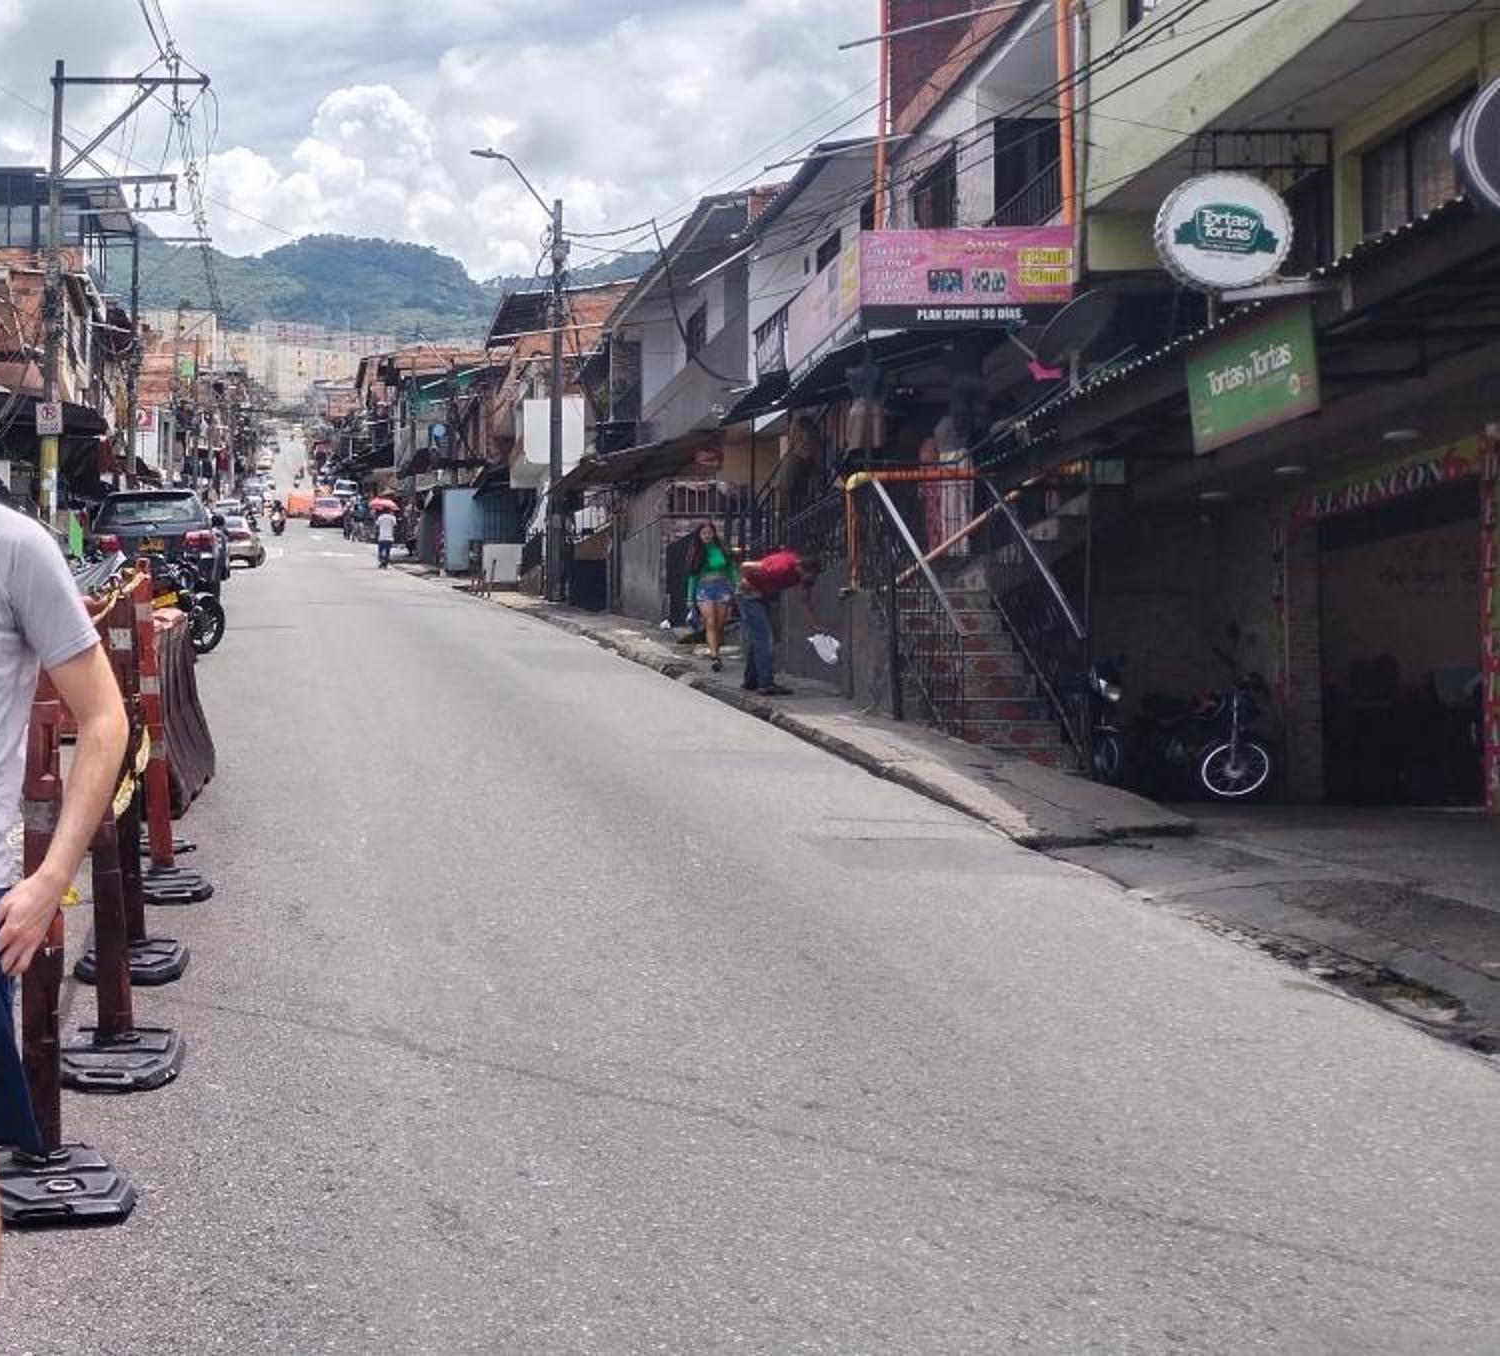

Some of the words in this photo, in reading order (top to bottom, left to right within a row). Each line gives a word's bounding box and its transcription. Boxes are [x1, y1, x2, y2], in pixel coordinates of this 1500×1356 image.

[1204, 223, 1252, 240] Tortas
[916, 308, 942, 321] PLAN
[982, 306, 996, 320] 30
[1205, 368, 1245, 397] Tortas
[1250, 343, 1292, 377] Tortas
